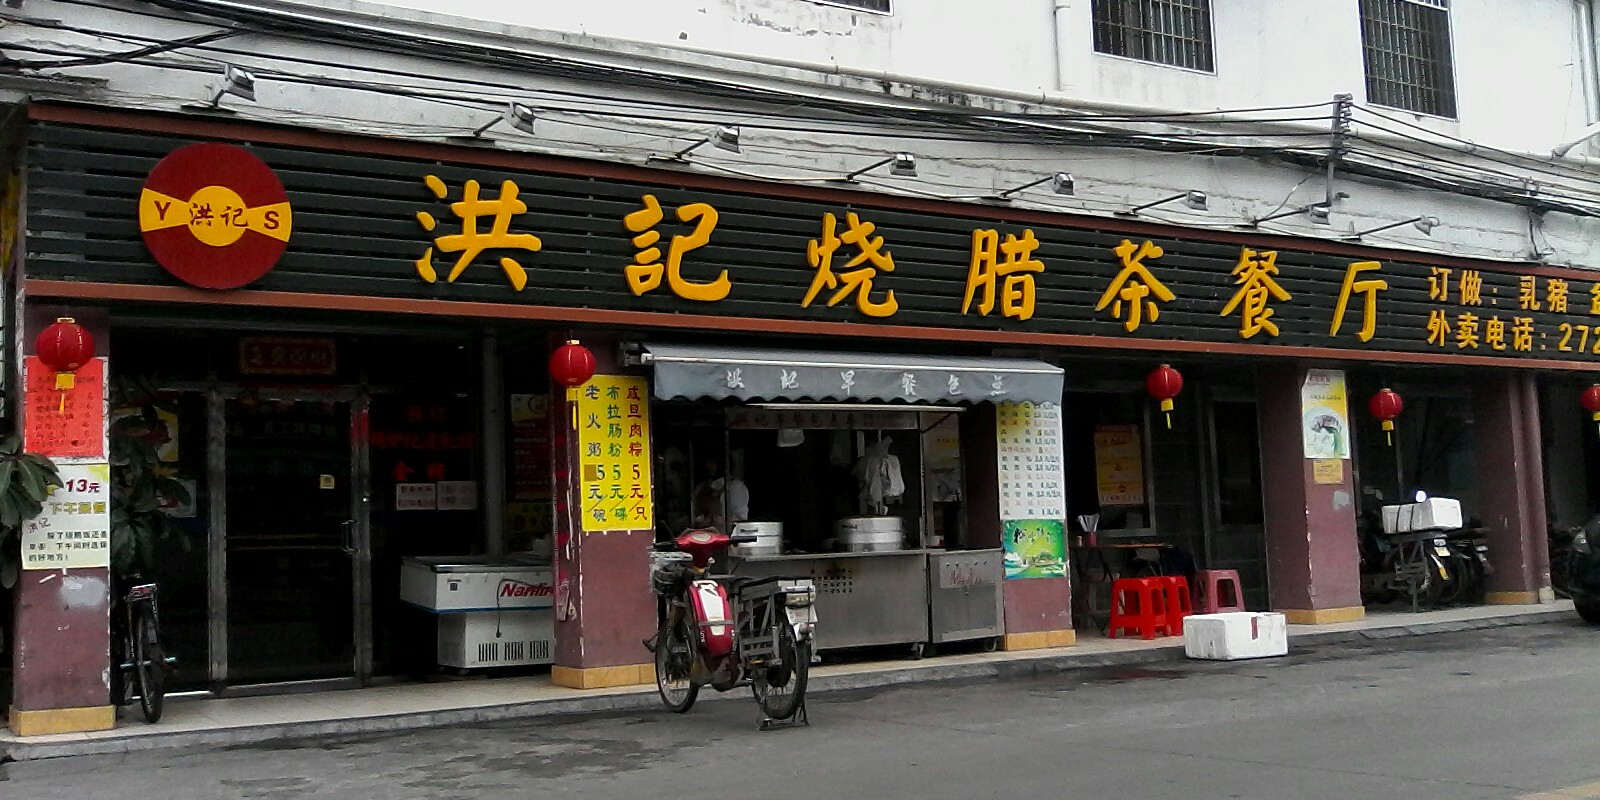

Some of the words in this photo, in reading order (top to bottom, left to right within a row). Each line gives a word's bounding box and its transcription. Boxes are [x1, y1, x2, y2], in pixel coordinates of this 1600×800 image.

[154, 200, 172, 221] Y
[188, 202, 249, 228] 洪记
[263, 210, 280, 230] S
[415, 174, 1389, 341] 洪記烧腊茶餐厅
